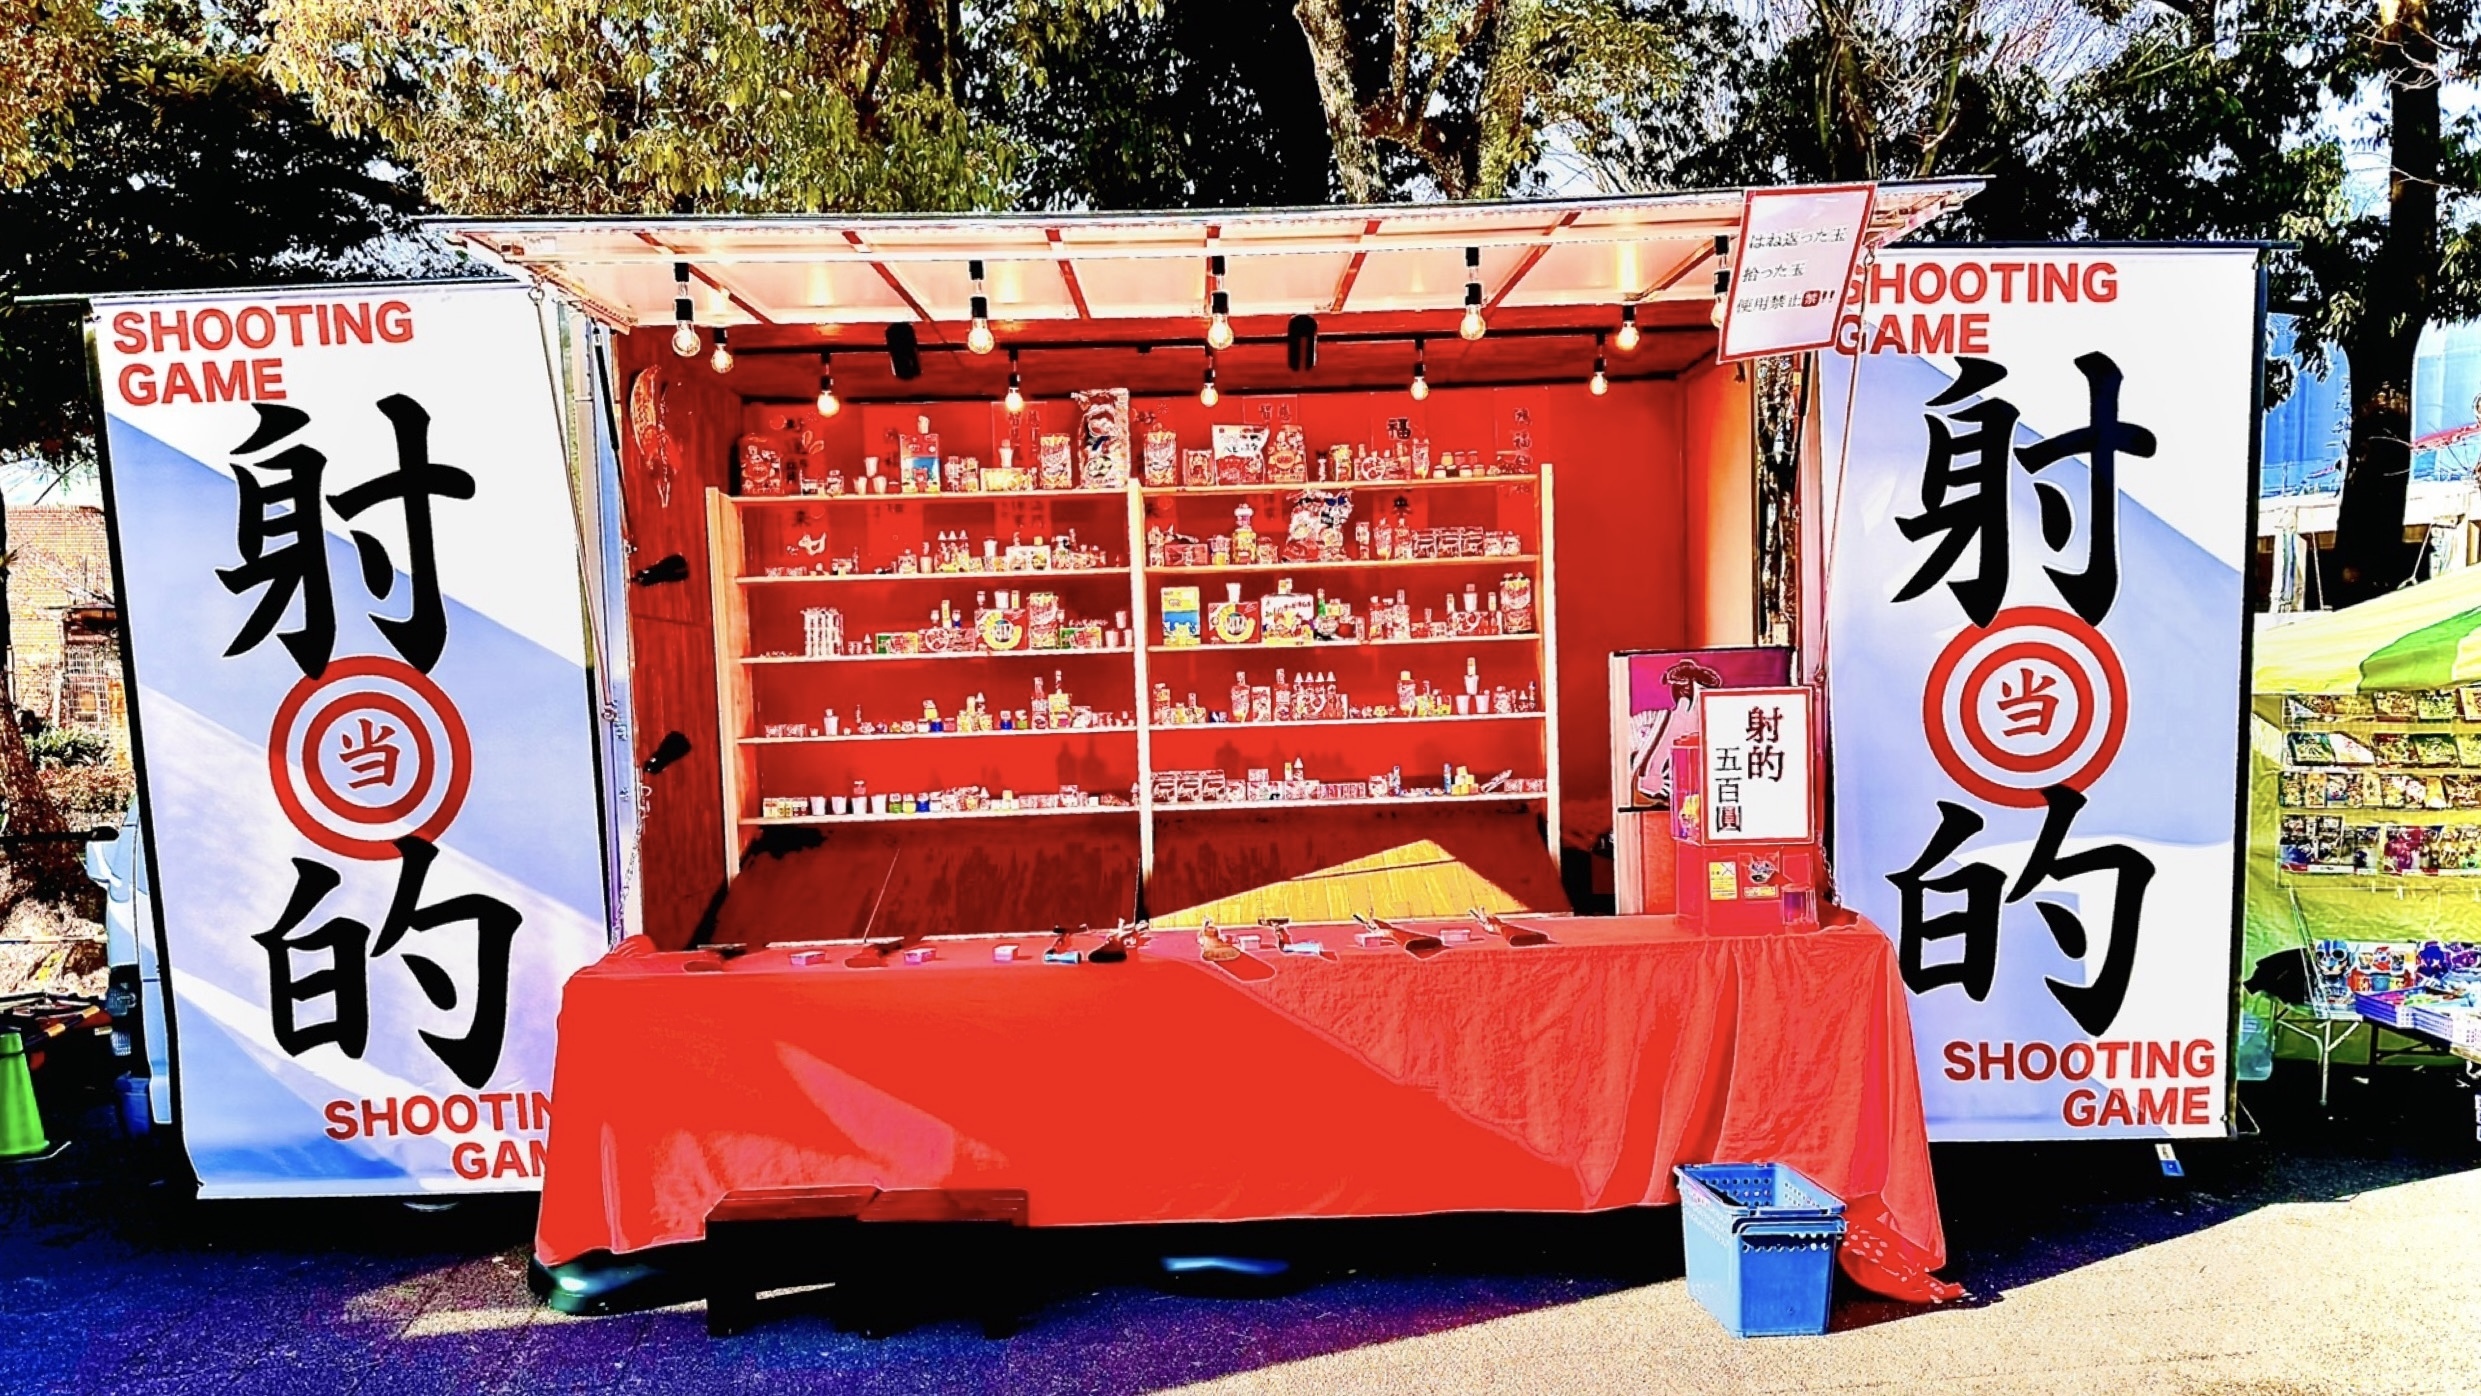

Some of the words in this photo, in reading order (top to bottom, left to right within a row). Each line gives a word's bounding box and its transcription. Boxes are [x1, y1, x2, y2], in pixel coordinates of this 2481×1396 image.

[1749, 227, 1847, 249] はね返った玉
[1742, 262, 1806, 283] 拾った玉
[1846, 262, 2118, 304] SHOOTING
[113, 300, 413, 354] SHOOTING
[1836, 313, 1990, 355] GAME
[119, 357, 287, 406] GAME
[1997, 668, 2060, 738] 当
[338, 718, 402, 790] 当
[1744, 705, 1785, 783] 射的
[1714, 745, 1744, 834] 五百圓
[1944, 1039, 2215, 1081] SHOOTING
[325, 1091, 551, 1140] SHOOTIN
[2063, 1086, 2210, 1128] GAME
